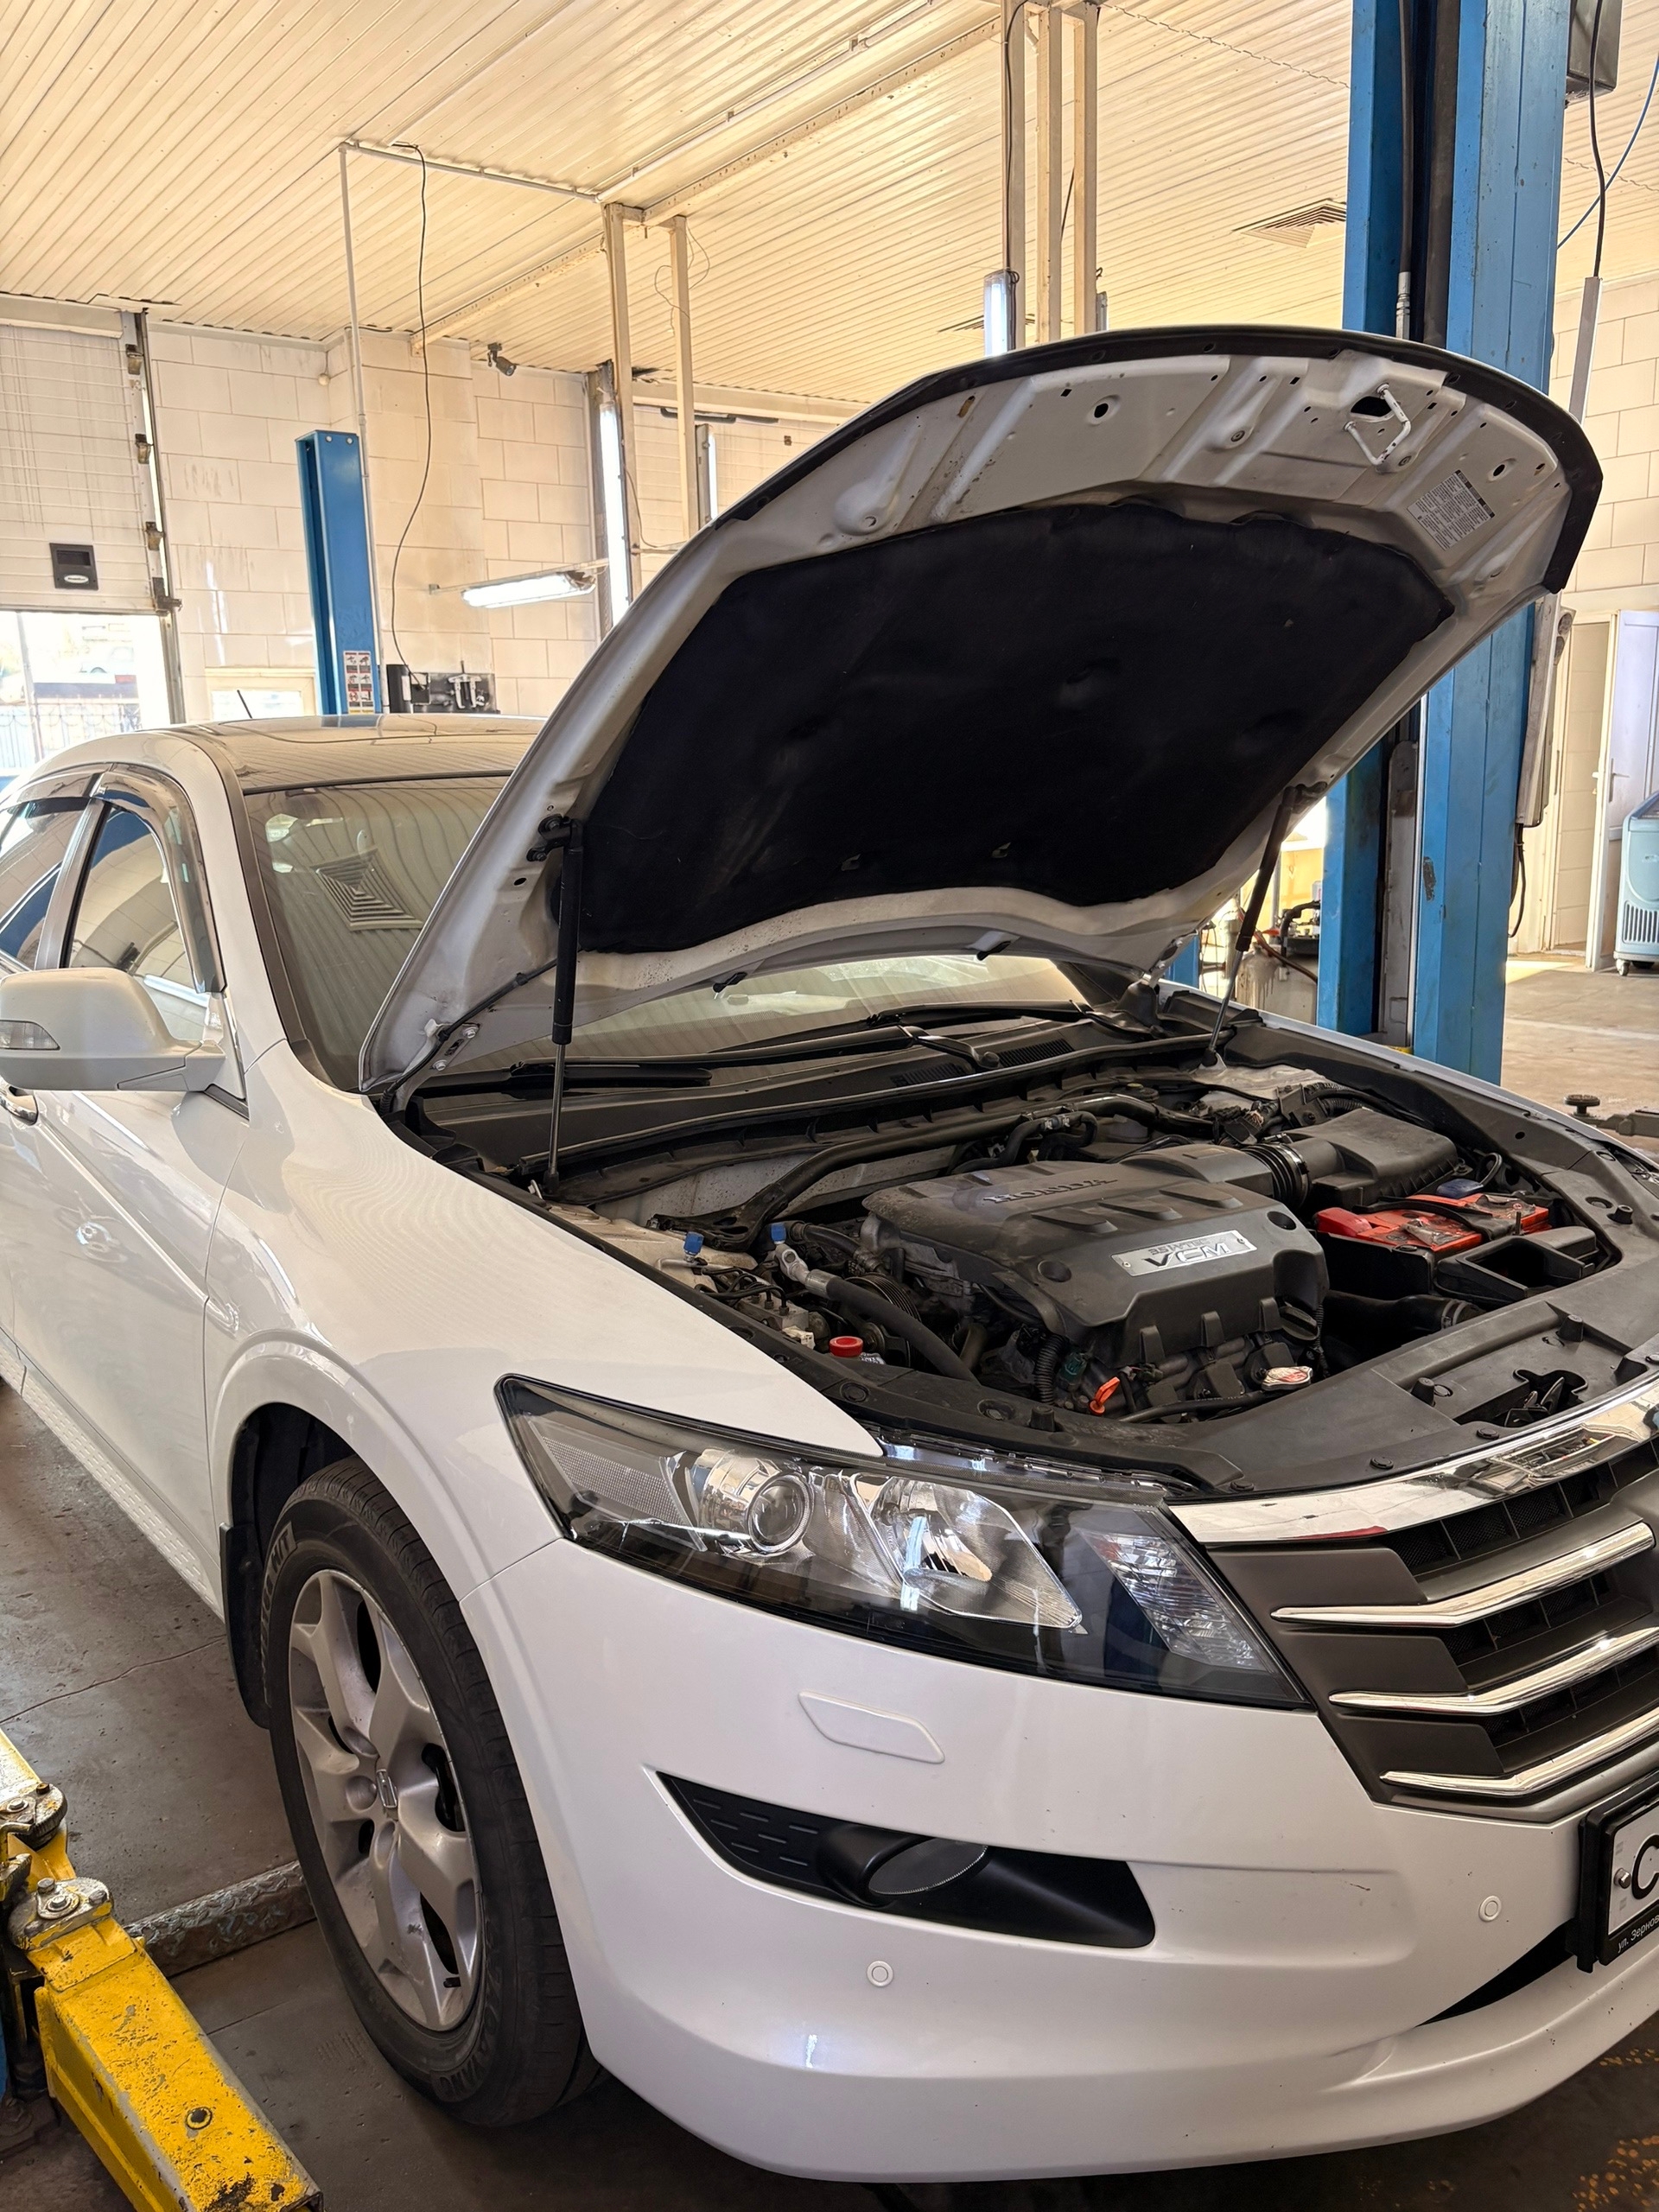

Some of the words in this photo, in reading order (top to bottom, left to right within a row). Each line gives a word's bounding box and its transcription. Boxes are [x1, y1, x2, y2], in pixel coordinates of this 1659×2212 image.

[983, 1179, 1118, 1204] HONDA
[1142, 1242, 1231, 1268] VCM
[1618, 1937, 1629, 1954] ул.
